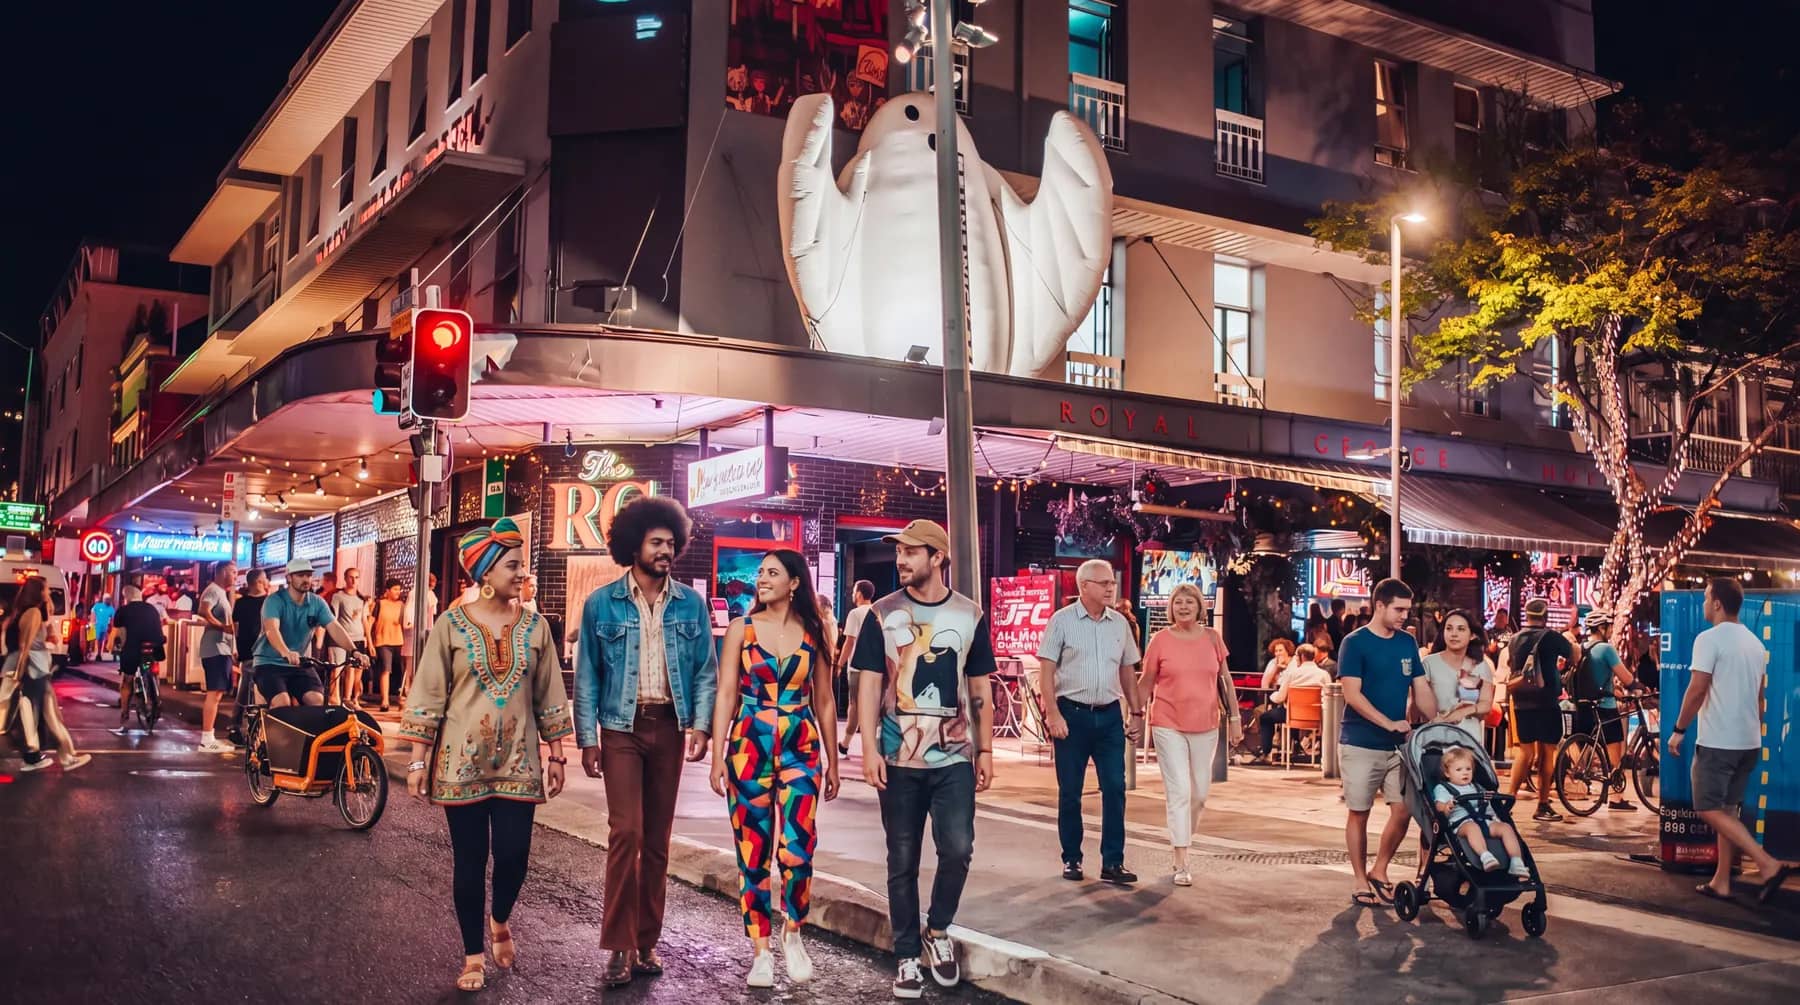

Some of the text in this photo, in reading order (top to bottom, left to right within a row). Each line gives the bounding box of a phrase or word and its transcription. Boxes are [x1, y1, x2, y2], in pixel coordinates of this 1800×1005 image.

[1060, 401, 1199, 439] ROYAL
[578, 449, 634, 482] The
[1314, 433, 1449, 469] GEOGE
[88, 539, 107, 554] 40
